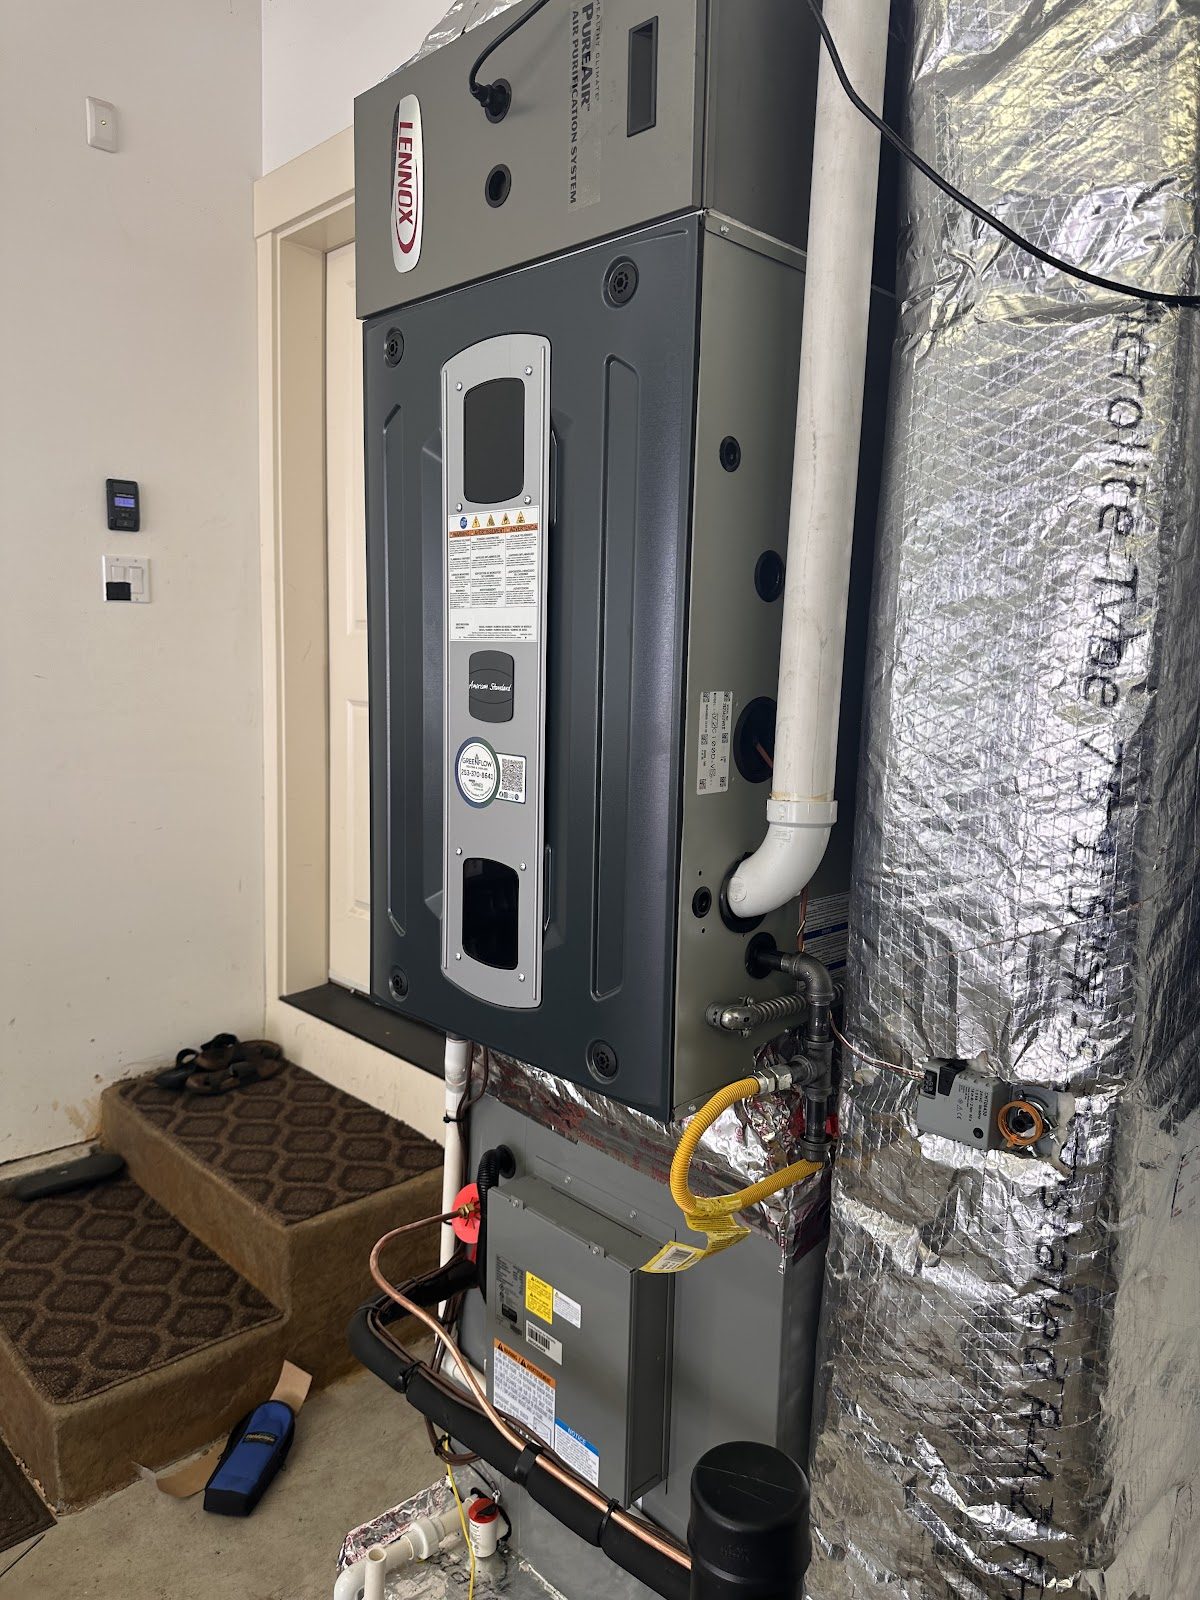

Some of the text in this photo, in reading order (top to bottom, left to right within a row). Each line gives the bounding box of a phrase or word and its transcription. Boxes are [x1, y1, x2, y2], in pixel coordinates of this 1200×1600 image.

[571, 39, 579, 143] PURIFICATION
[397, 121, 414, 225] LENNOX
[570, 146, 578, 204] SYSTEM
[489, 682, 512, 692] Standard
[567, 1427, 586, 1445] NOTICE
